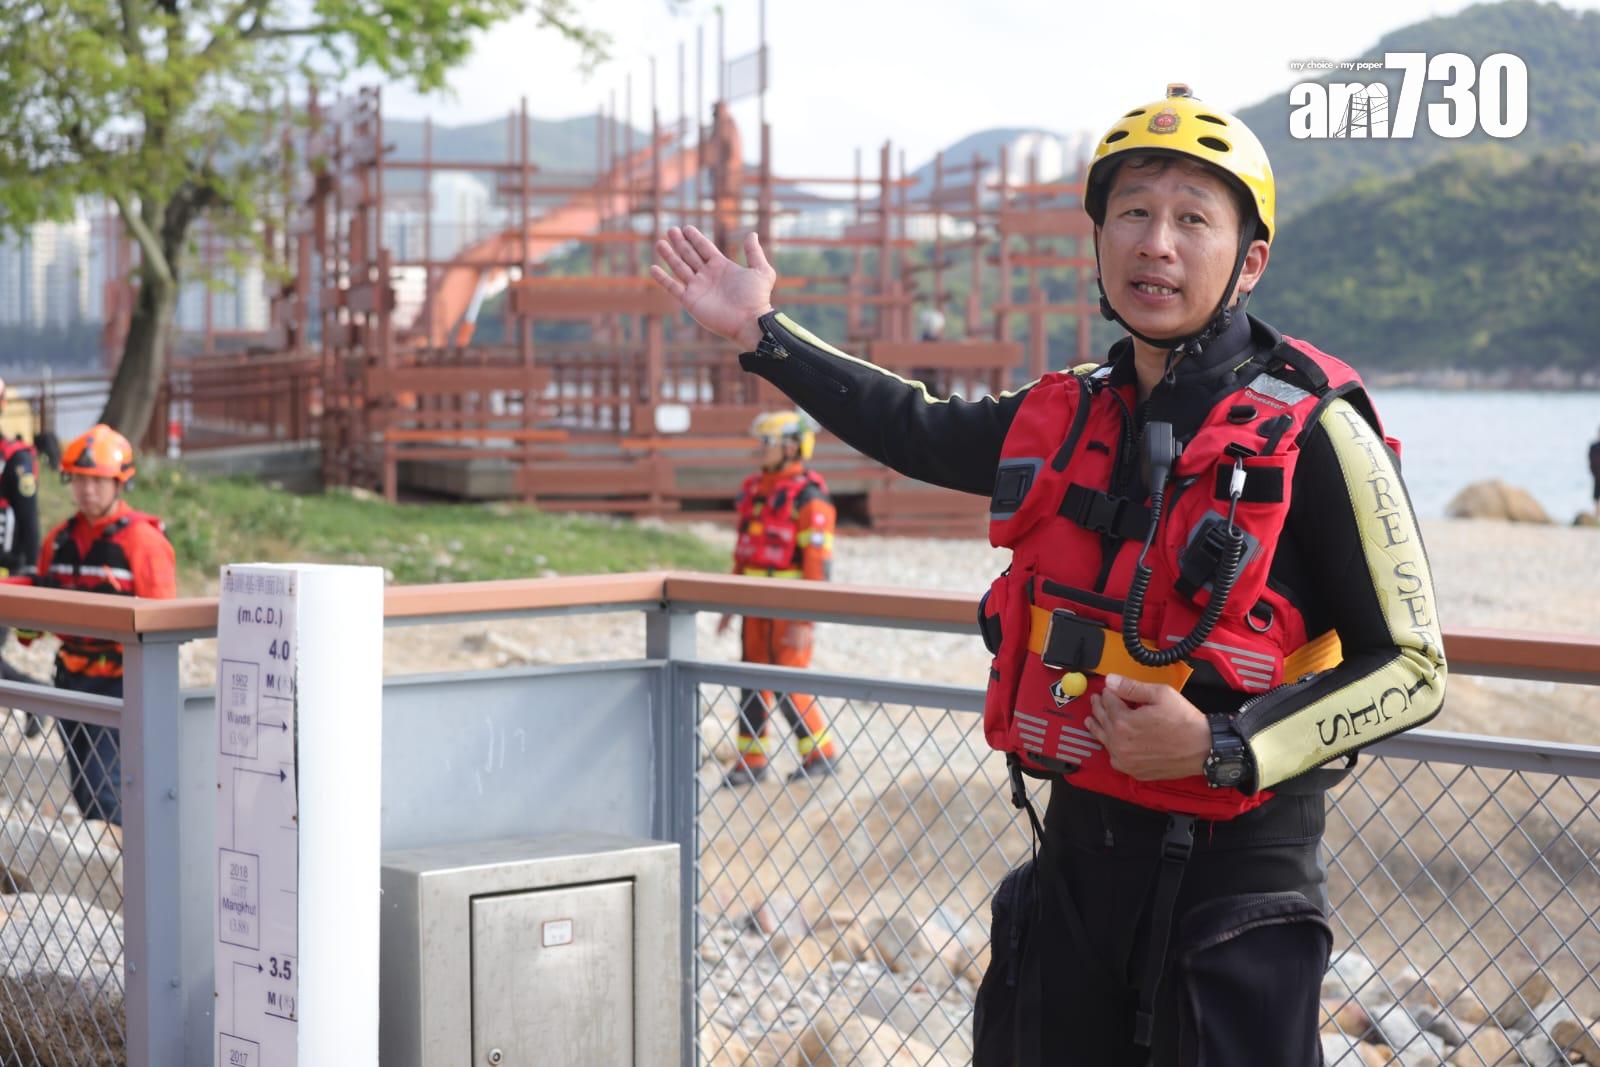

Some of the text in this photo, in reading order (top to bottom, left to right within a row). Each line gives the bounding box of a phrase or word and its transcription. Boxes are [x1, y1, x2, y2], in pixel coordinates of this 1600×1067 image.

[1316, 410, 1446, 748] FIRE SERICES
[237, 606, 283, 629] (m.C.D.)
[268, 638, 291, 661] 4.0
[266, 673, 275, 689] M
[230, 863, 248, 879] 2018
[269, 956, 292, 980] 3.5
[267, 991, 276, 1006] M
[230, 1048, 249, 1066] 2017
